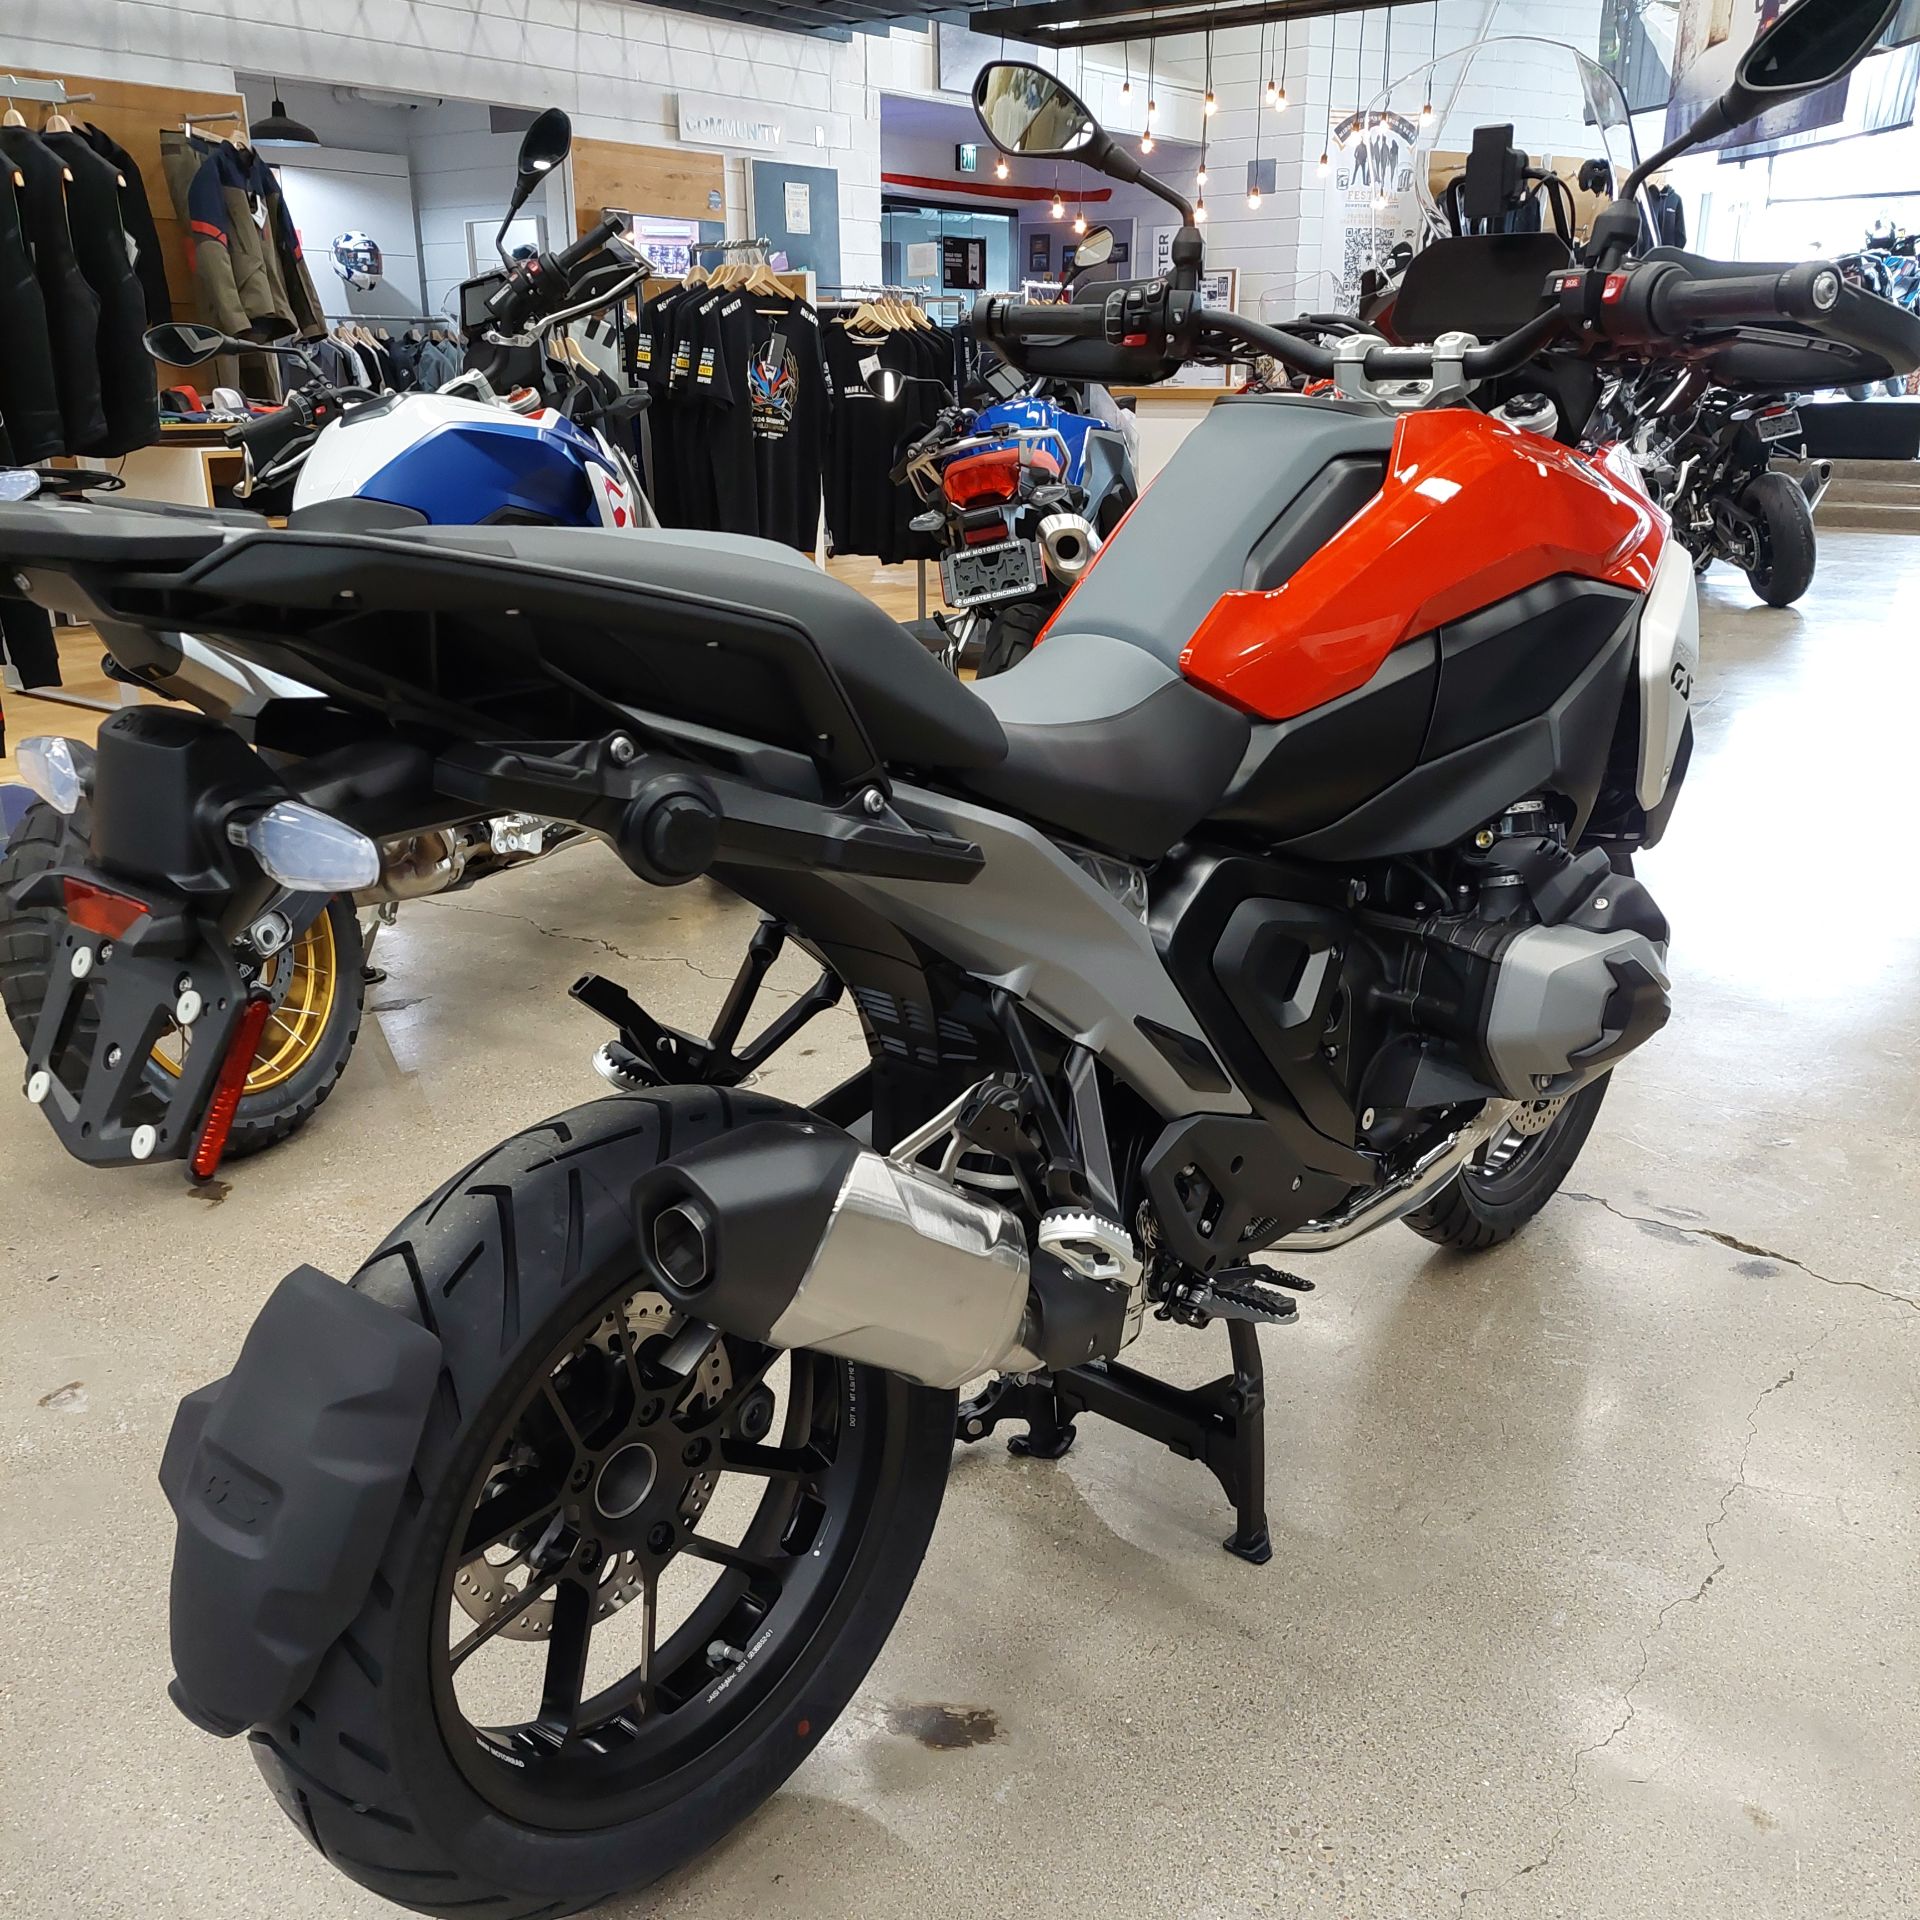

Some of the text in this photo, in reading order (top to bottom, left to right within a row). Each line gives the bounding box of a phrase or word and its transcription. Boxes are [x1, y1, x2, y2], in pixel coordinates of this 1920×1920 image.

[685, 116, 781, 145] COMMUNITY
[962, 147, 976, 170] EXIT
[1565, 278, 1578, 287] SOS
[956, 541, 1020, 559] BMW MOTORCYCLES
[963, 586, 1027, 604] GREATER CINCINNATI
[1670, 661, 1694, 702] GS
